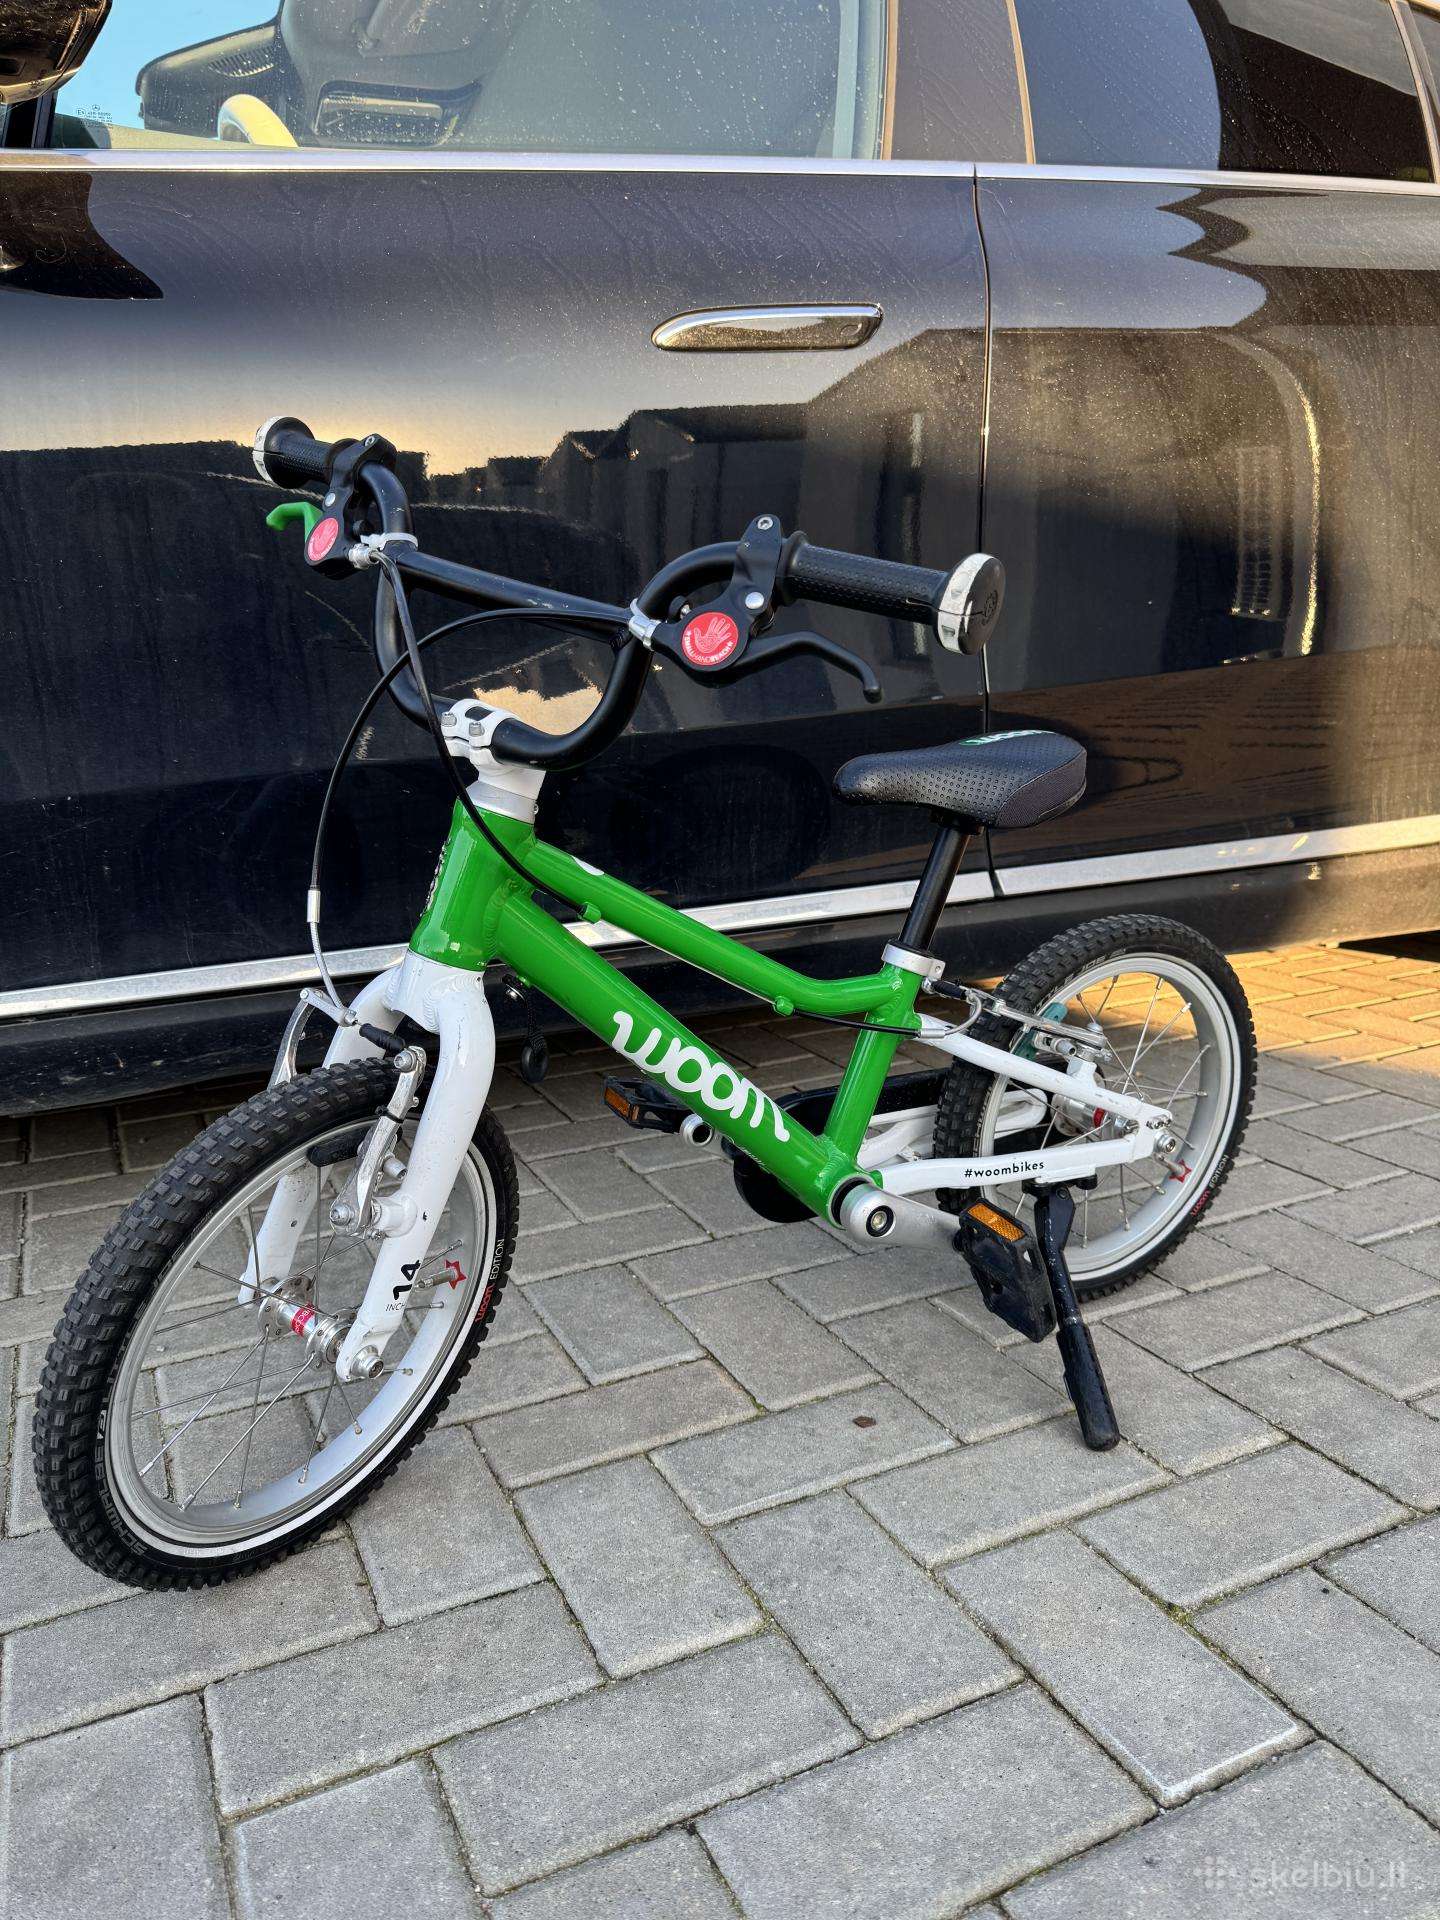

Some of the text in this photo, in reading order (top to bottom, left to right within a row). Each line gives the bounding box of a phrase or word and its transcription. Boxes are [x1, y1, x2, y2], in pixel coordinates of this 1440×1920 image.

[611, 1010, 790, 1142] woom
[964, 1161, 1045, 1178] #woombikes
[1208, 1154, 1230, 1188] EDITION
[393, 1259, 421, 1300] 14
[489, 1238, 505, 1280] EDITION
[94, 1445, 148, 1556] SCHWALBE
